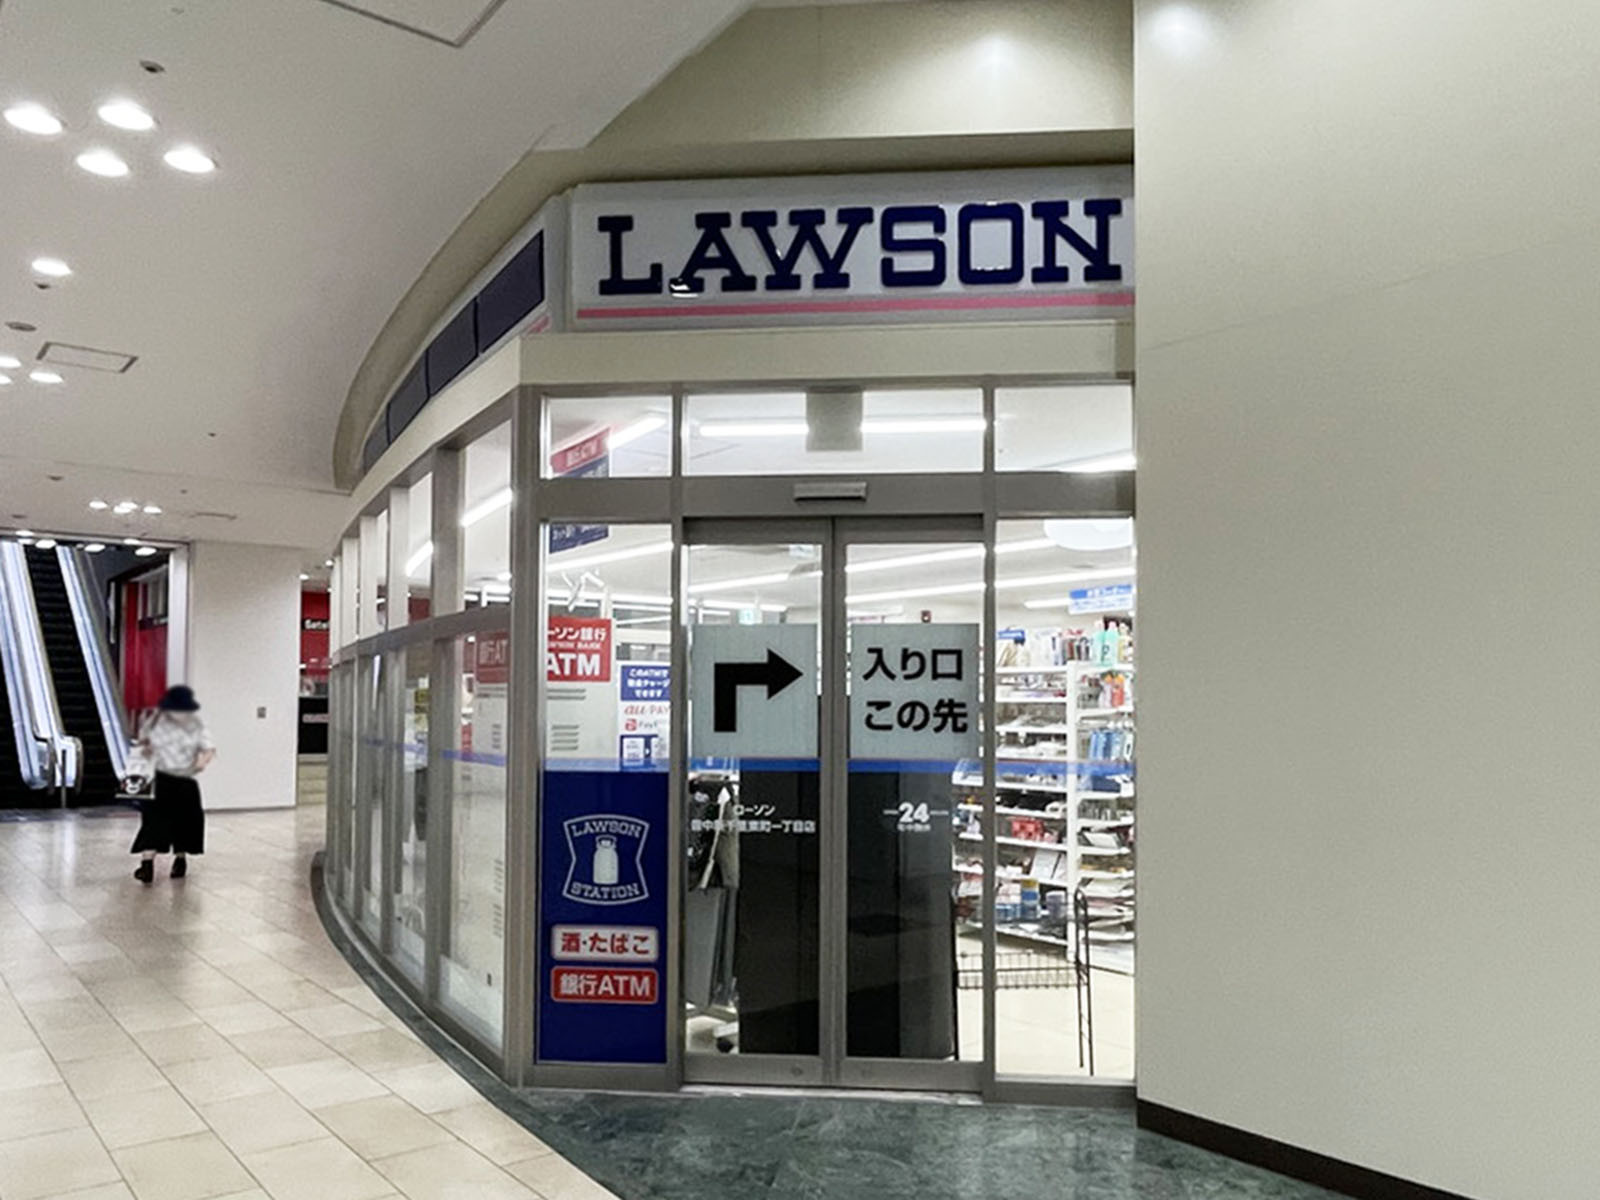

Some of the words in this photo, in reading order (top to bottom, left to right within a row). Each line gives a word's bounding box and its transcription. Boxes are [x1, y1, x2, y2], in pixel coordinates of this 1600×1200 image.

[598, 198, 1123, 296] LAWSON
[547, 627, 606, 641] ーソン銀行
[546, 653, 600, 675] ATM
[863, 647, 964, 682] 入り口
[864, 698, 969, 734] この先
[733, 804, 776, 816] ローソン
[898, 801, 930, 823] 24
[570, 820, 643, 839] LAWSON
[570, 882, 640, 900] STATION
[559, 973, 651, 998] 銀行ATM
